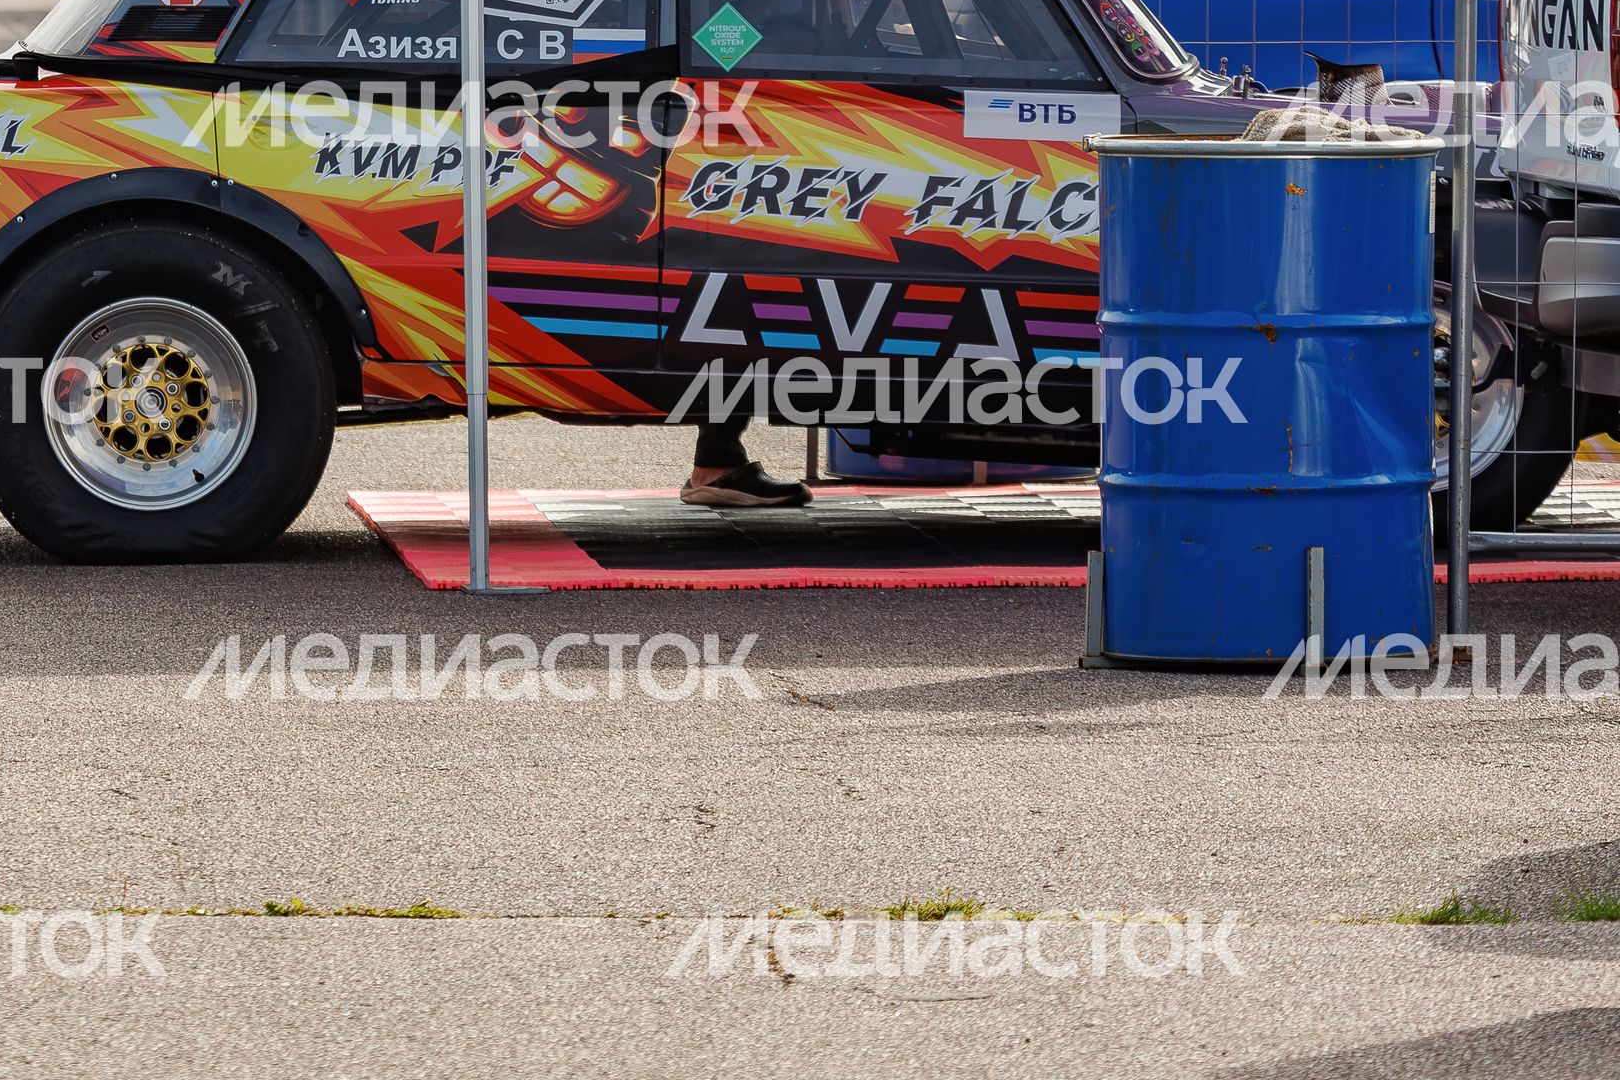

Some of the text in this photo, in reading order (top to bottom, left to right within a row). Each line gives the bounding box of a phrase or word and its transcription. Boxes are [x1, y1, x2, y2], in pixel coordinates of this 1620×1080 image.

[337, 28, 457, 59] Азизя
[1017, 102, 1077, 125] ВТБ
[681, 157, 1100, 241] GREY FALC
